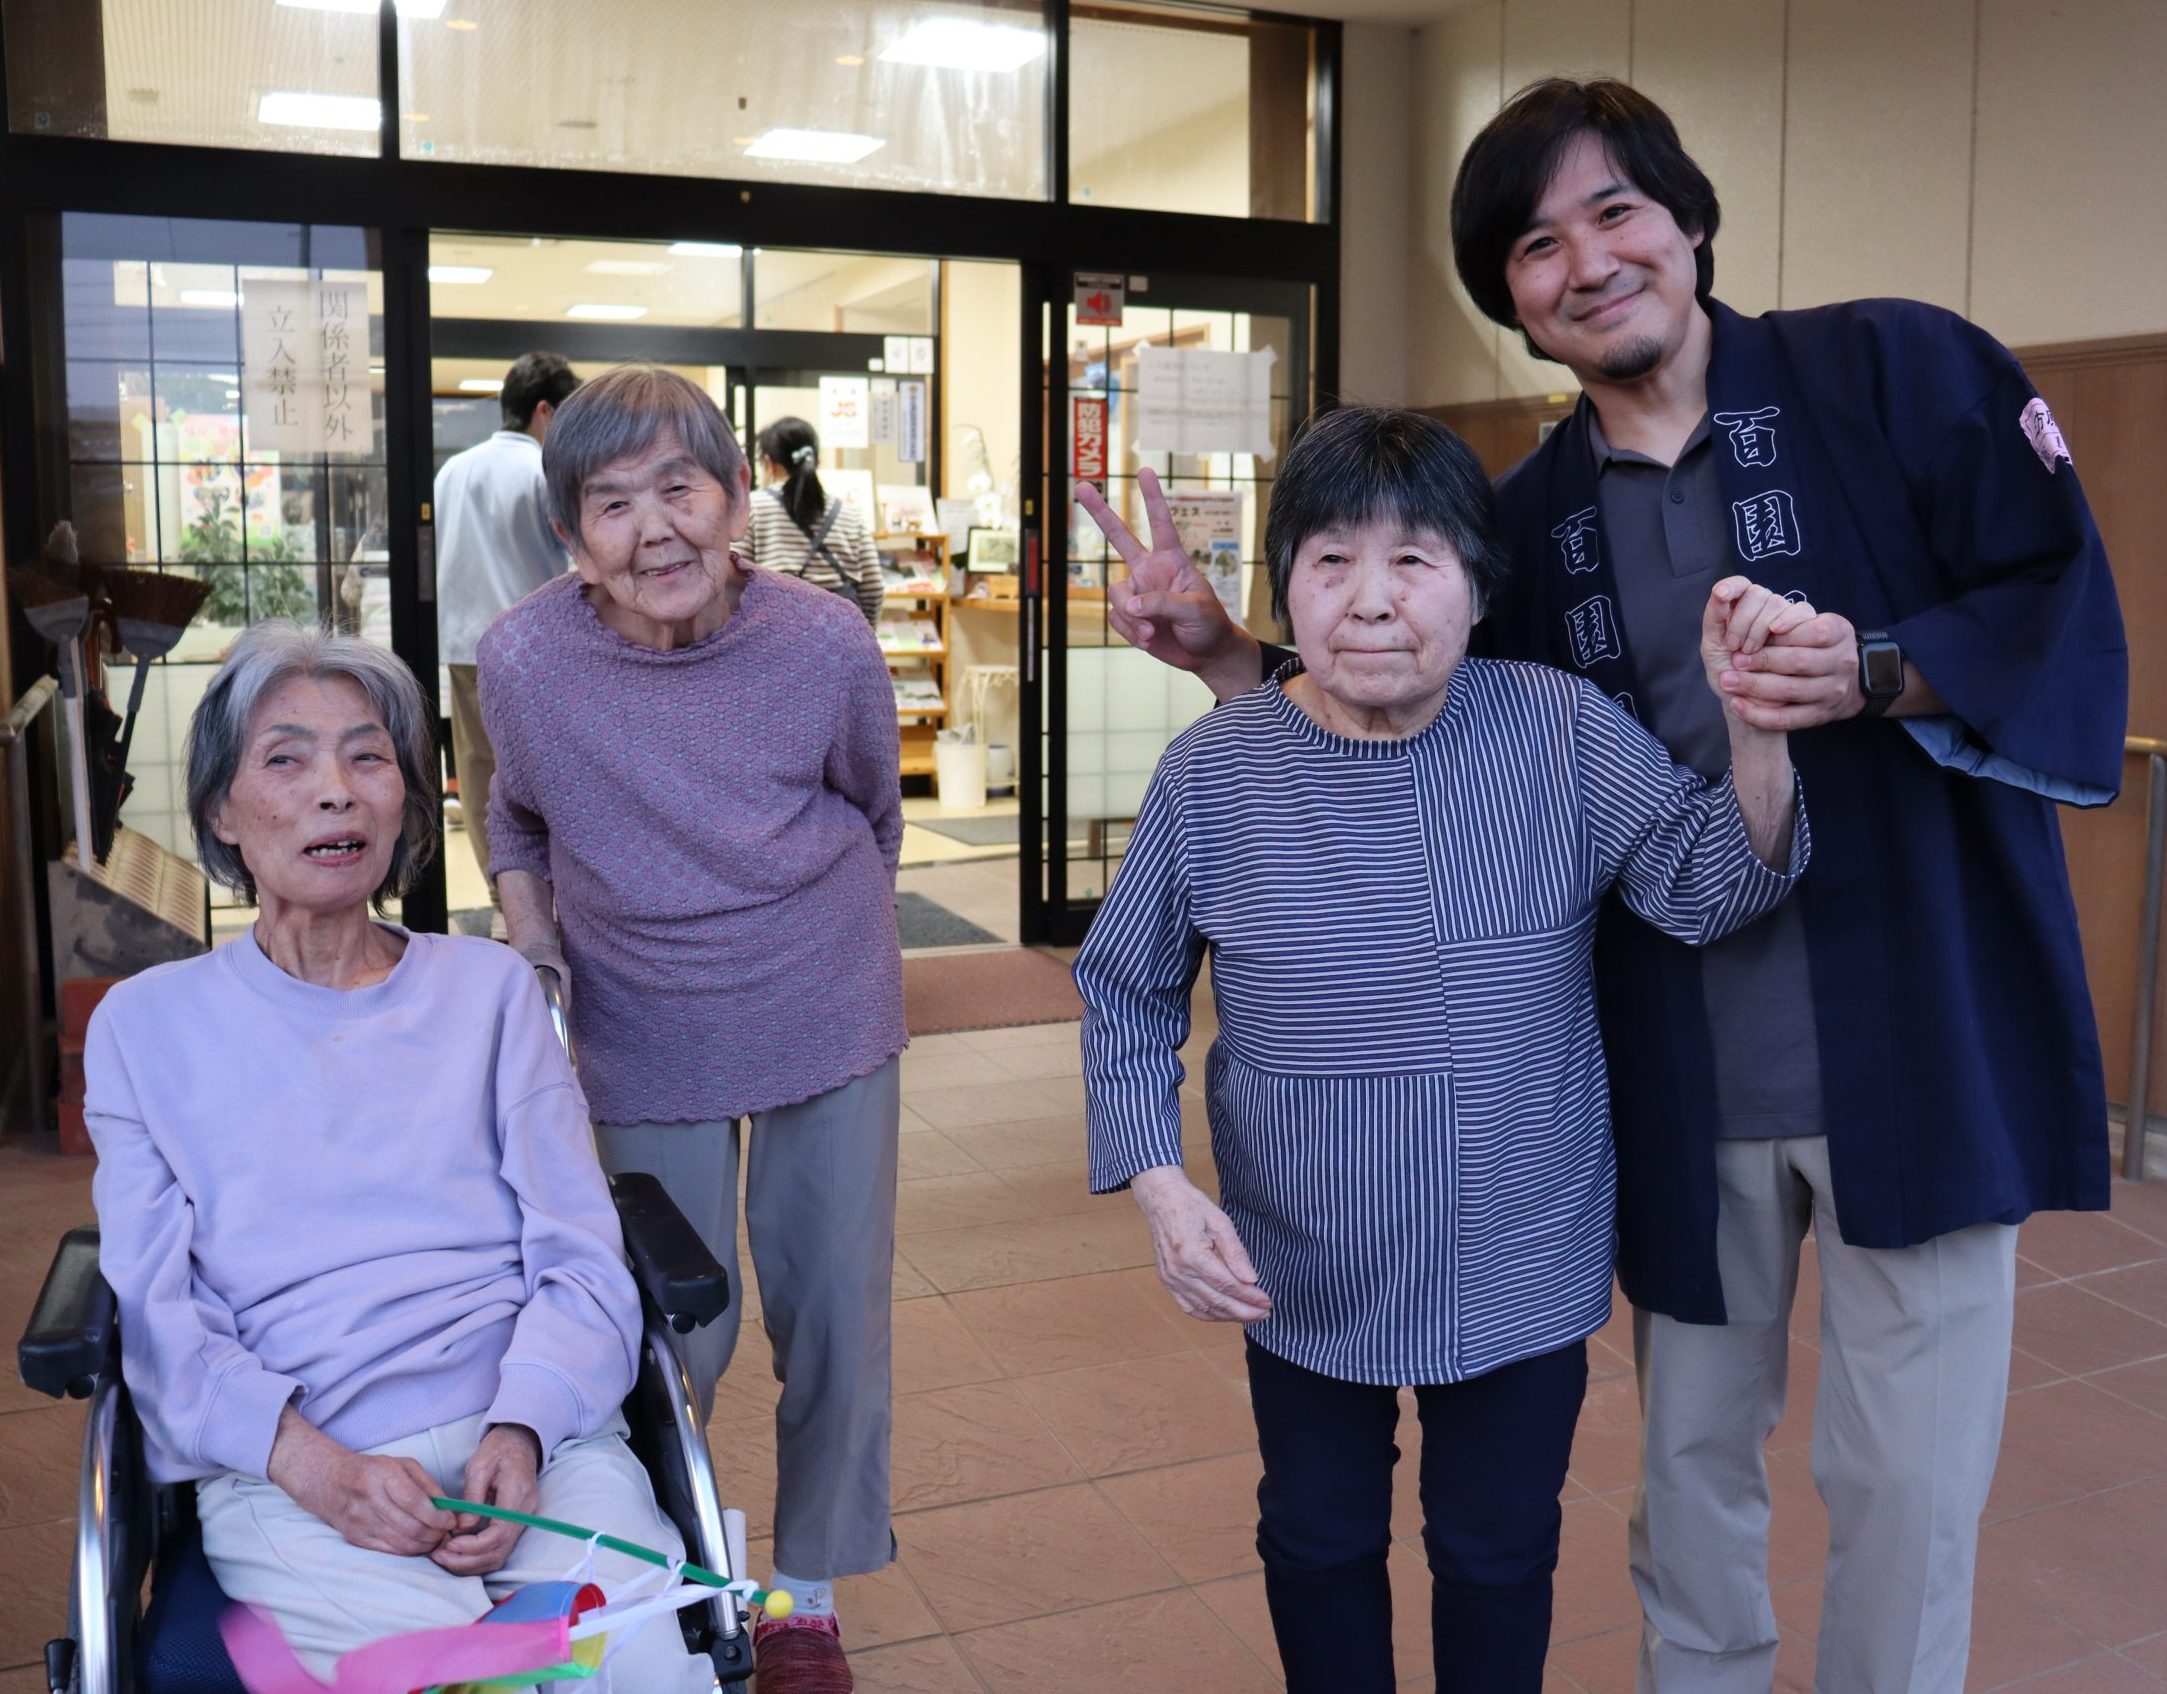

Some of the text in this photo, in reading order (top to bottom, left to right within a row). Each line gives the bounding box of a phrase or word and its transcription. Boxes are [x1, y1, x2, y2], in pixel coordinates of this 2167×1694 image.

[266, 304, 299, 426] 立入禁止
[319, 290, 353, 441] 関係者以外
[1077, 401, 1103, 477] 防犯カメラ
[1713, 405, 1806, 605] 百園
[1551, 505, 1641, 727] 百園
